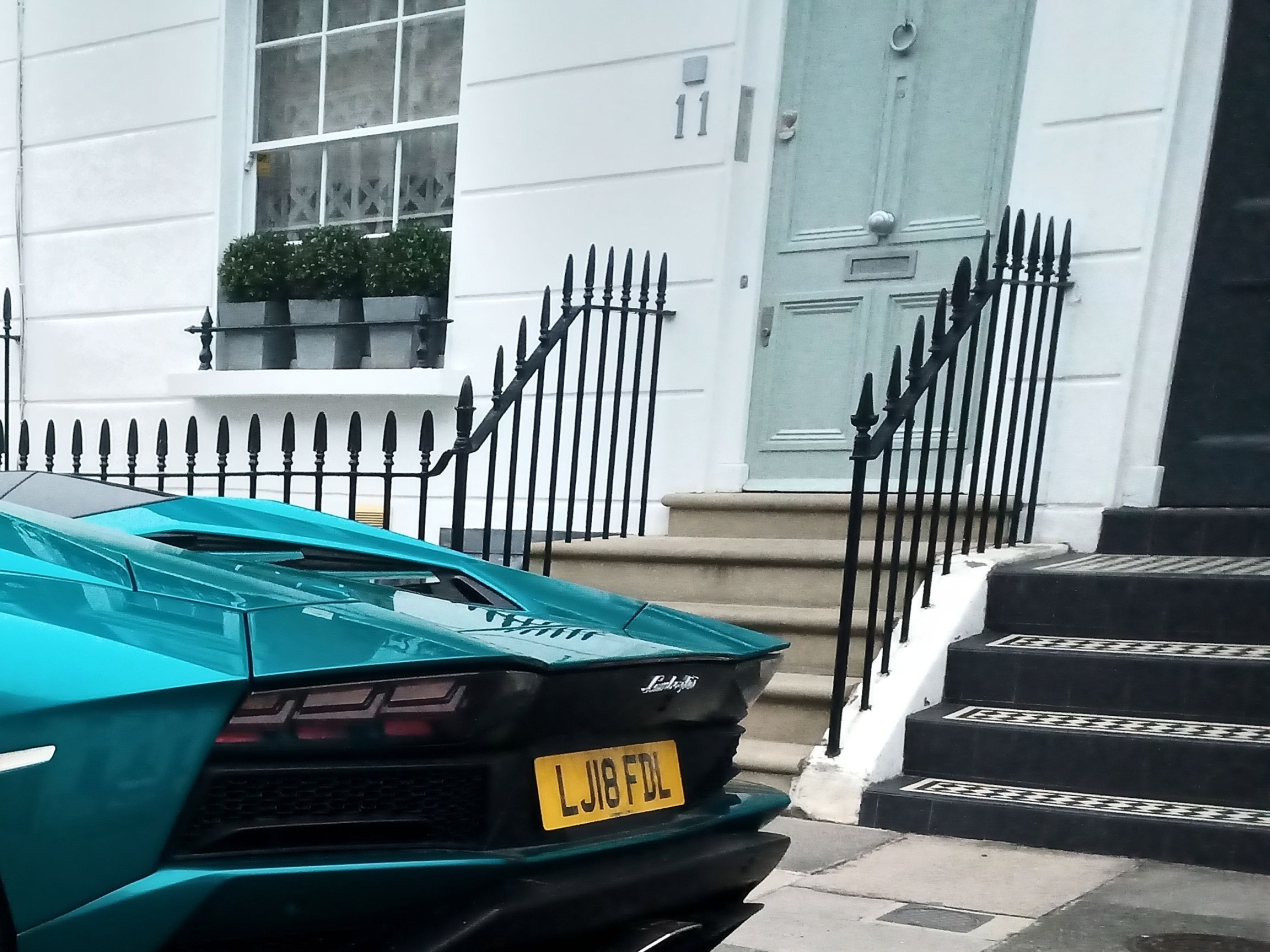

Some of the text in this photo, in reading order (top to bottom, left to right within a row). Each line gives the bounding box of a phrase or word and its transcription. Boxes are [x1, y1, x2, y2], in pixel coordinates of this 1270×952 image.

[674, 90, 710, 139] 11
[555, 751, 672, 817] LJ18 FDL
